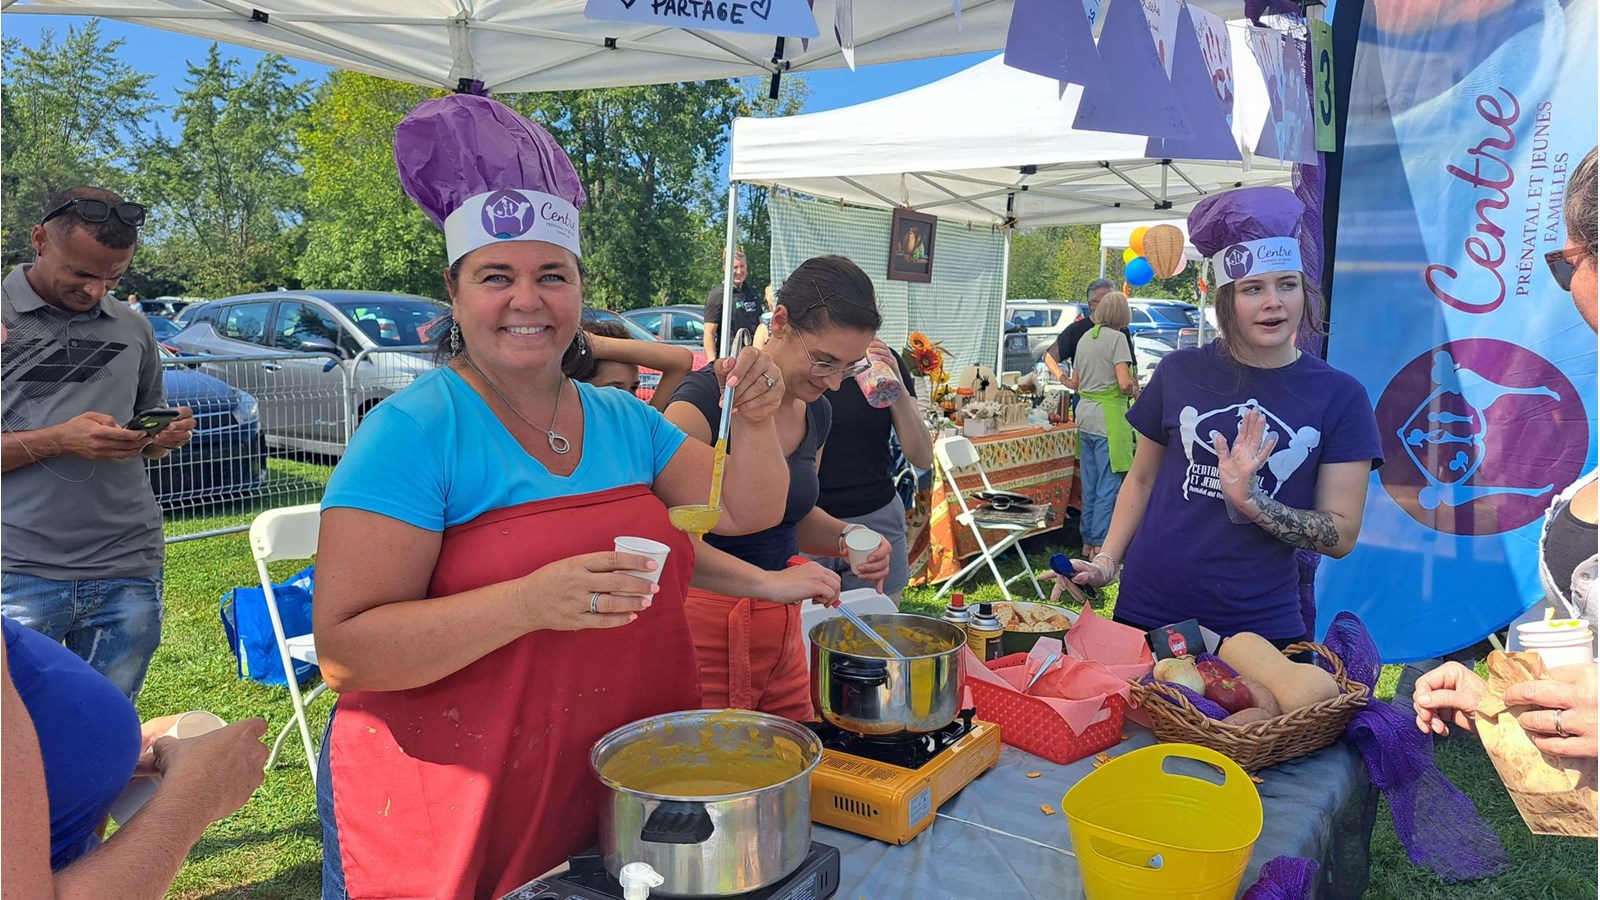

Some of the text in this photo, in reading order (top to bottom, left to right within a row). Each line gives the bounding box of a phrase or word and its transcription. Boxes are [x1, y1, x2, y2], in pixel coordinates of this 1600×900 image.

[651, 0, 748, 25] PARTAGE
[1319, 48, 1332, 127] 3
[540, 201, 576, 231] Centre
[1425, 86, 1520, 315] Centre
[1515, 101, 1553, 297] PRÉNATAL ET JEUNES
[1543, 152, 1569, 243] FAMILLES
[1256, 244, 1293, 260] Centre
